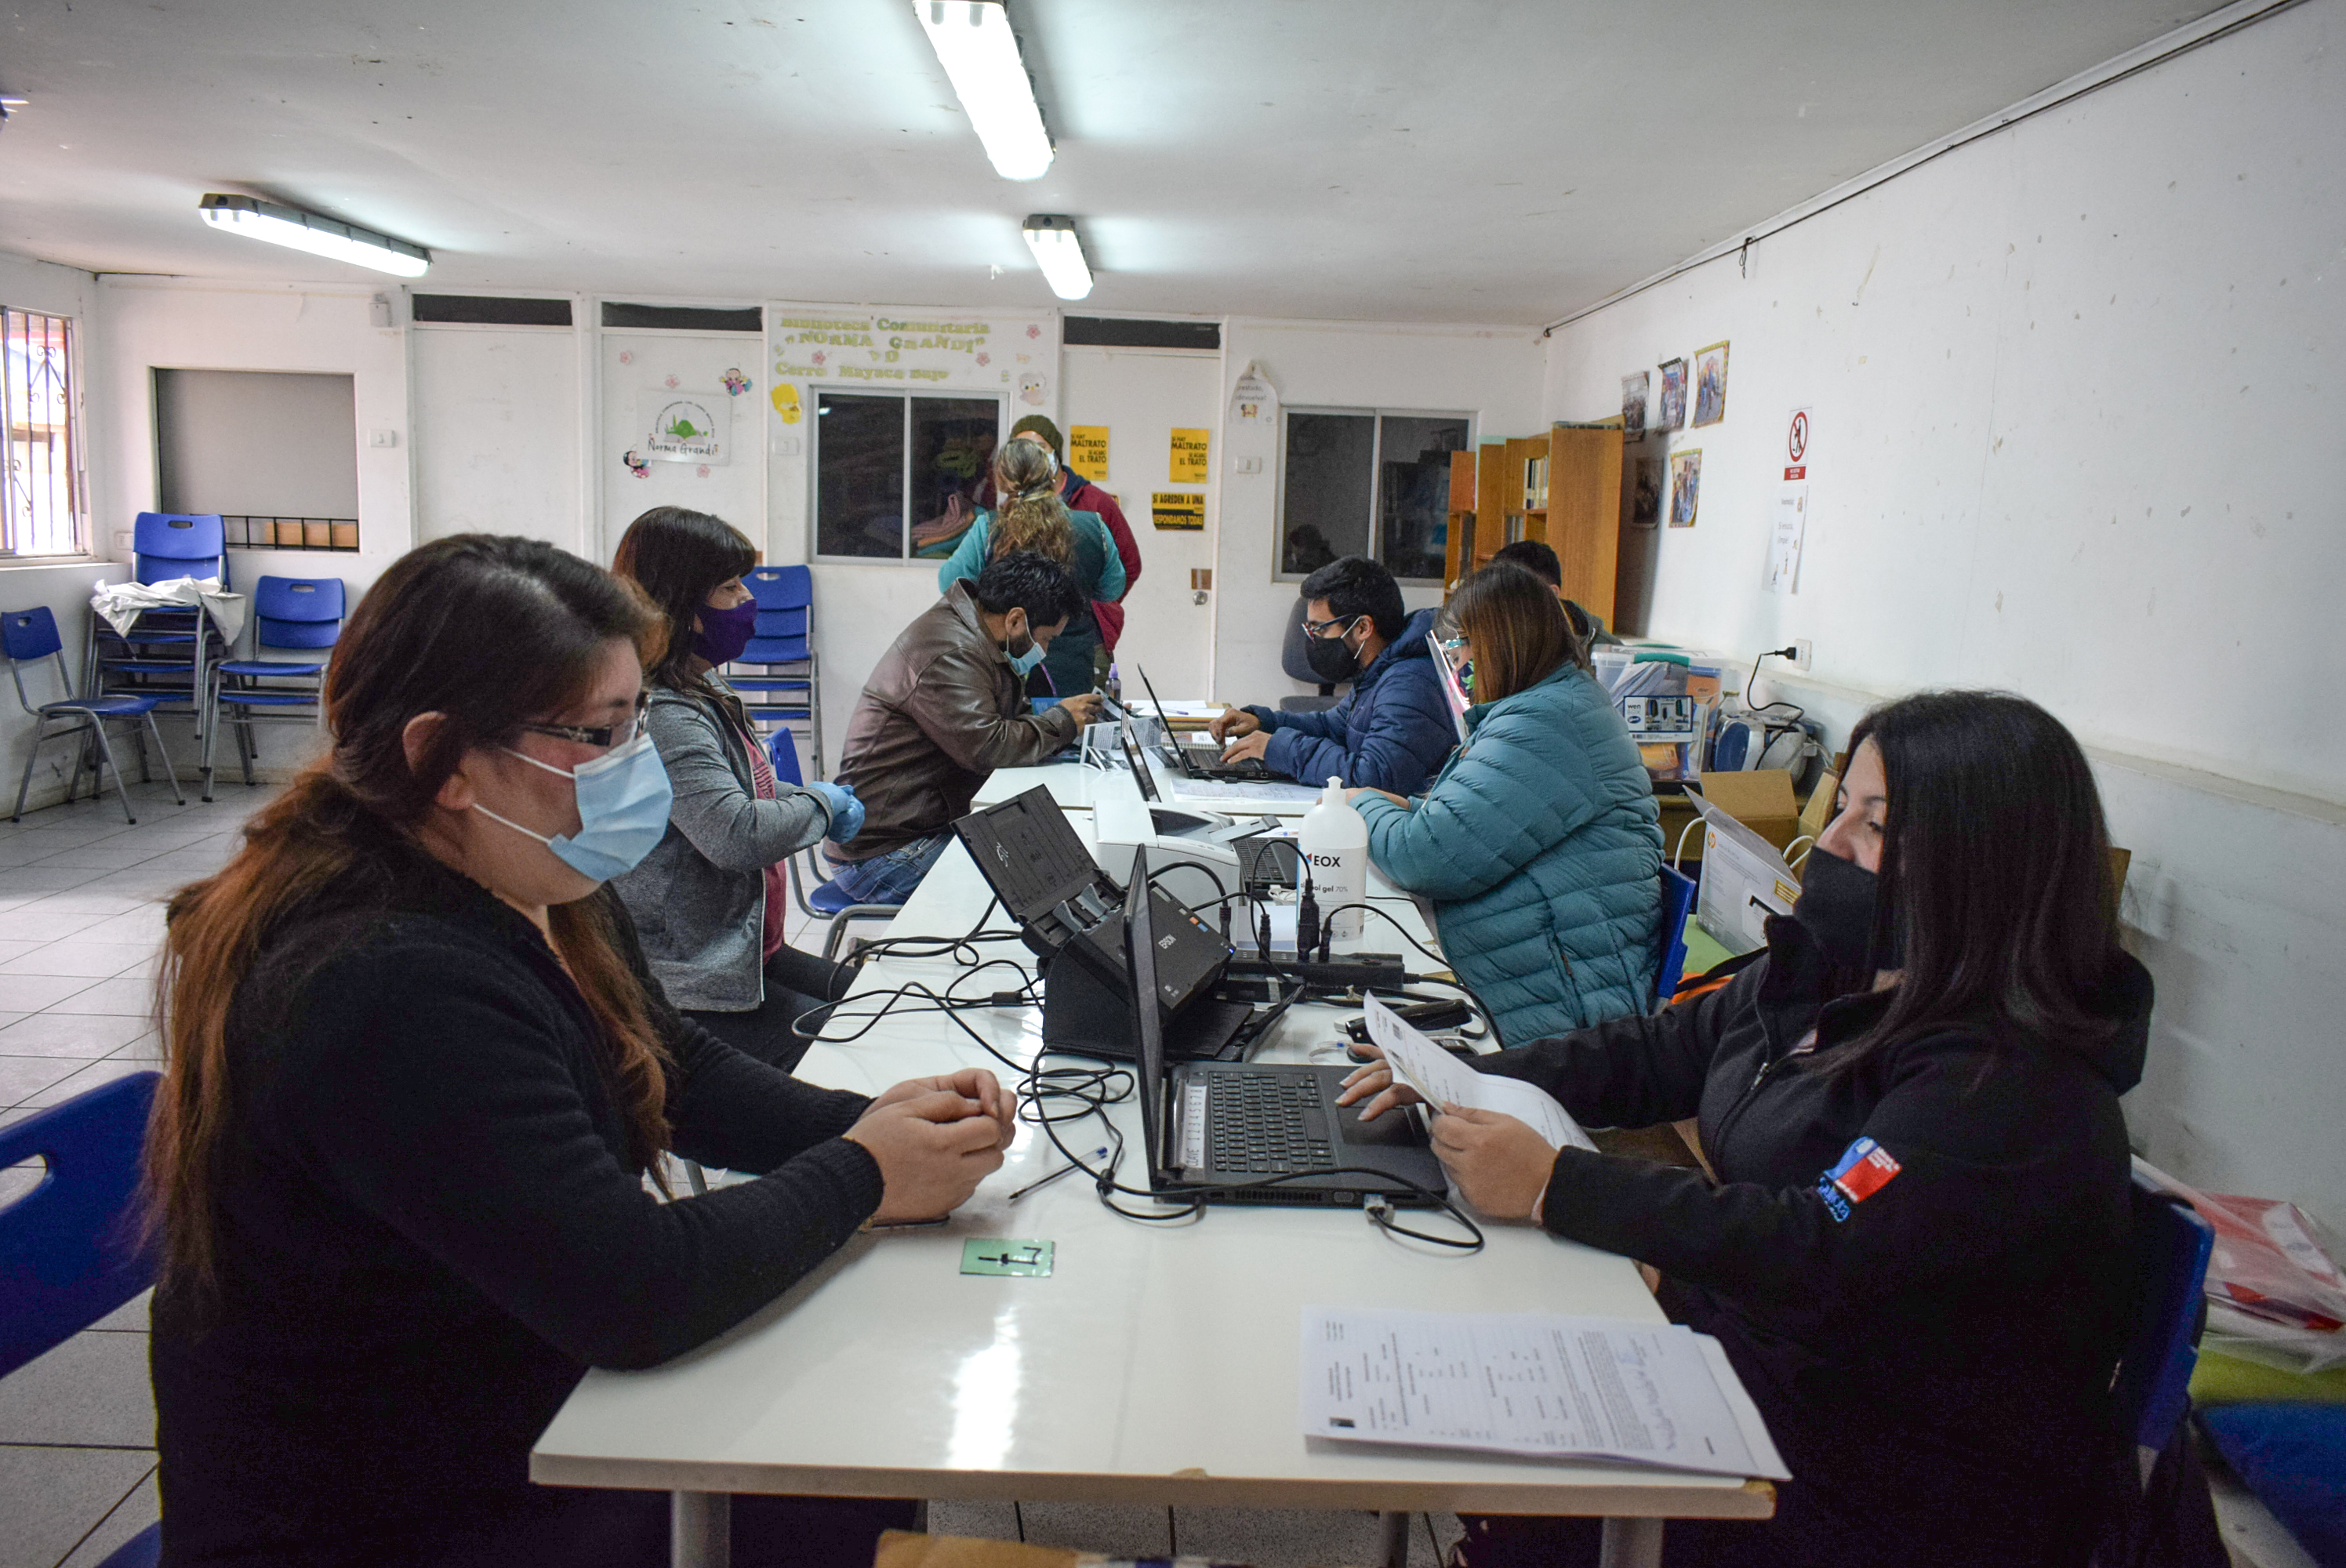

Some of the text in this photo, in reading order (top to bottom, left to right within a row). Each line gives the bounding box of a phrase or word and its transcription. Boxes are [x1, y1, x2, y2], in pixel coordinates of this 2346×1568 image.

[776, 361, 826, 377] Cerro
[648, 439, 714, 456] Norma Grandi
[1171, 442, 1207, 451] MALTRATO
[1160, 494, 1185, 504] AGREDEN
[1187, 495, 1190, 503] A
[1192, 495, 1204, 504] UNA
[1188, 515, 1203, 524] TODAS
[1322, 885, 1334, 894] gel
[1157, 934, 1176, 949] EPSON
